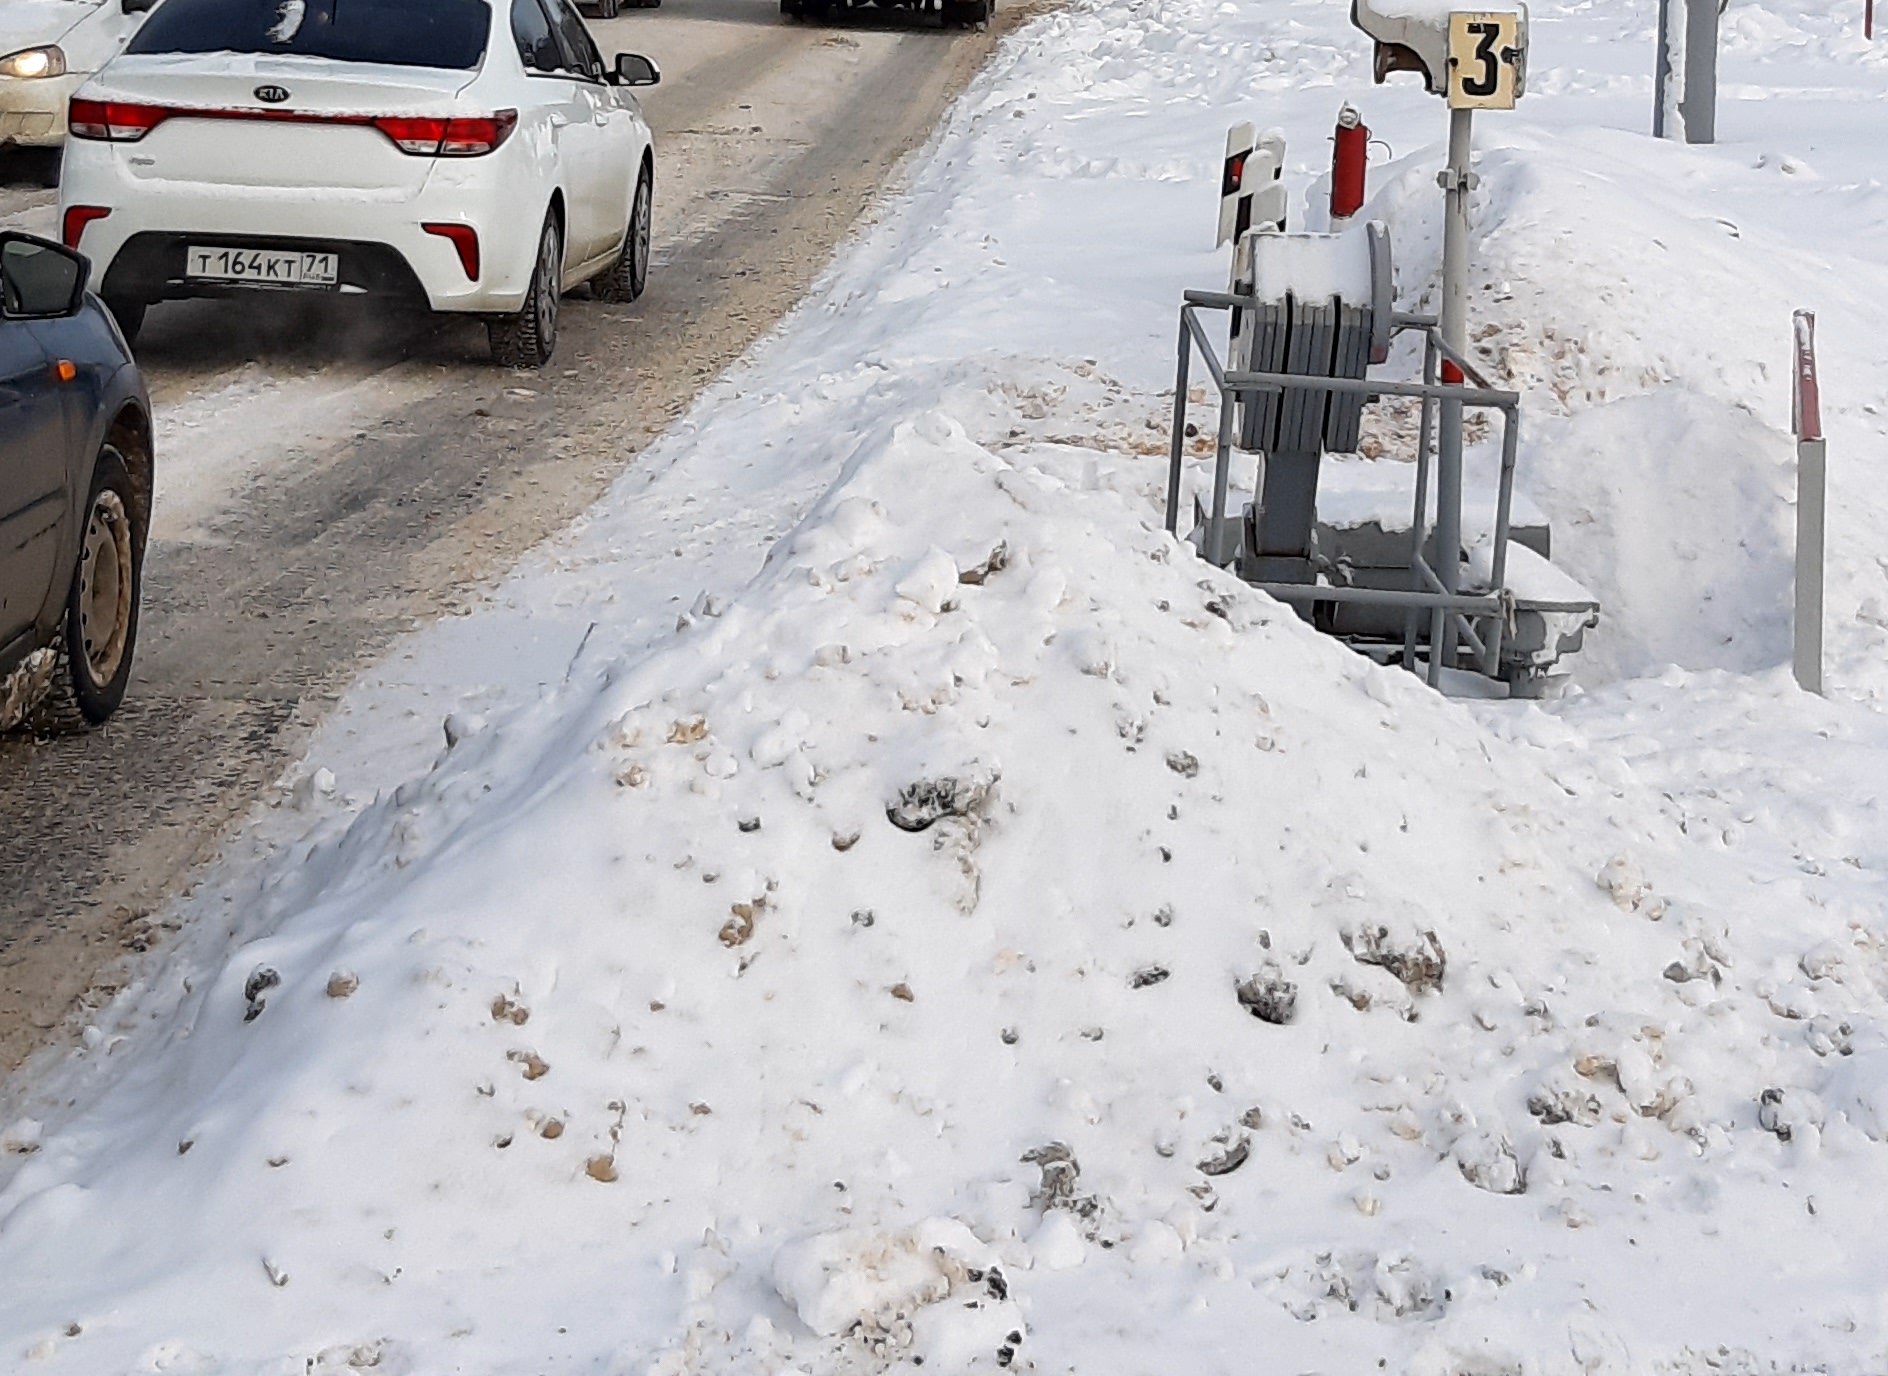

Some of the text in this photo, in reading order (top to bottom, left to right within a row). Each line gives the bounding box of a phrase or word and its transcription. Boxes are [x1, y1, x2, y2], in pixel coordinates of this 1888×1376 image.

[1461, 22, 1501, 96] 3
[258, 87, 286, 100] KIA
[304, 253, 330, 274] 71
